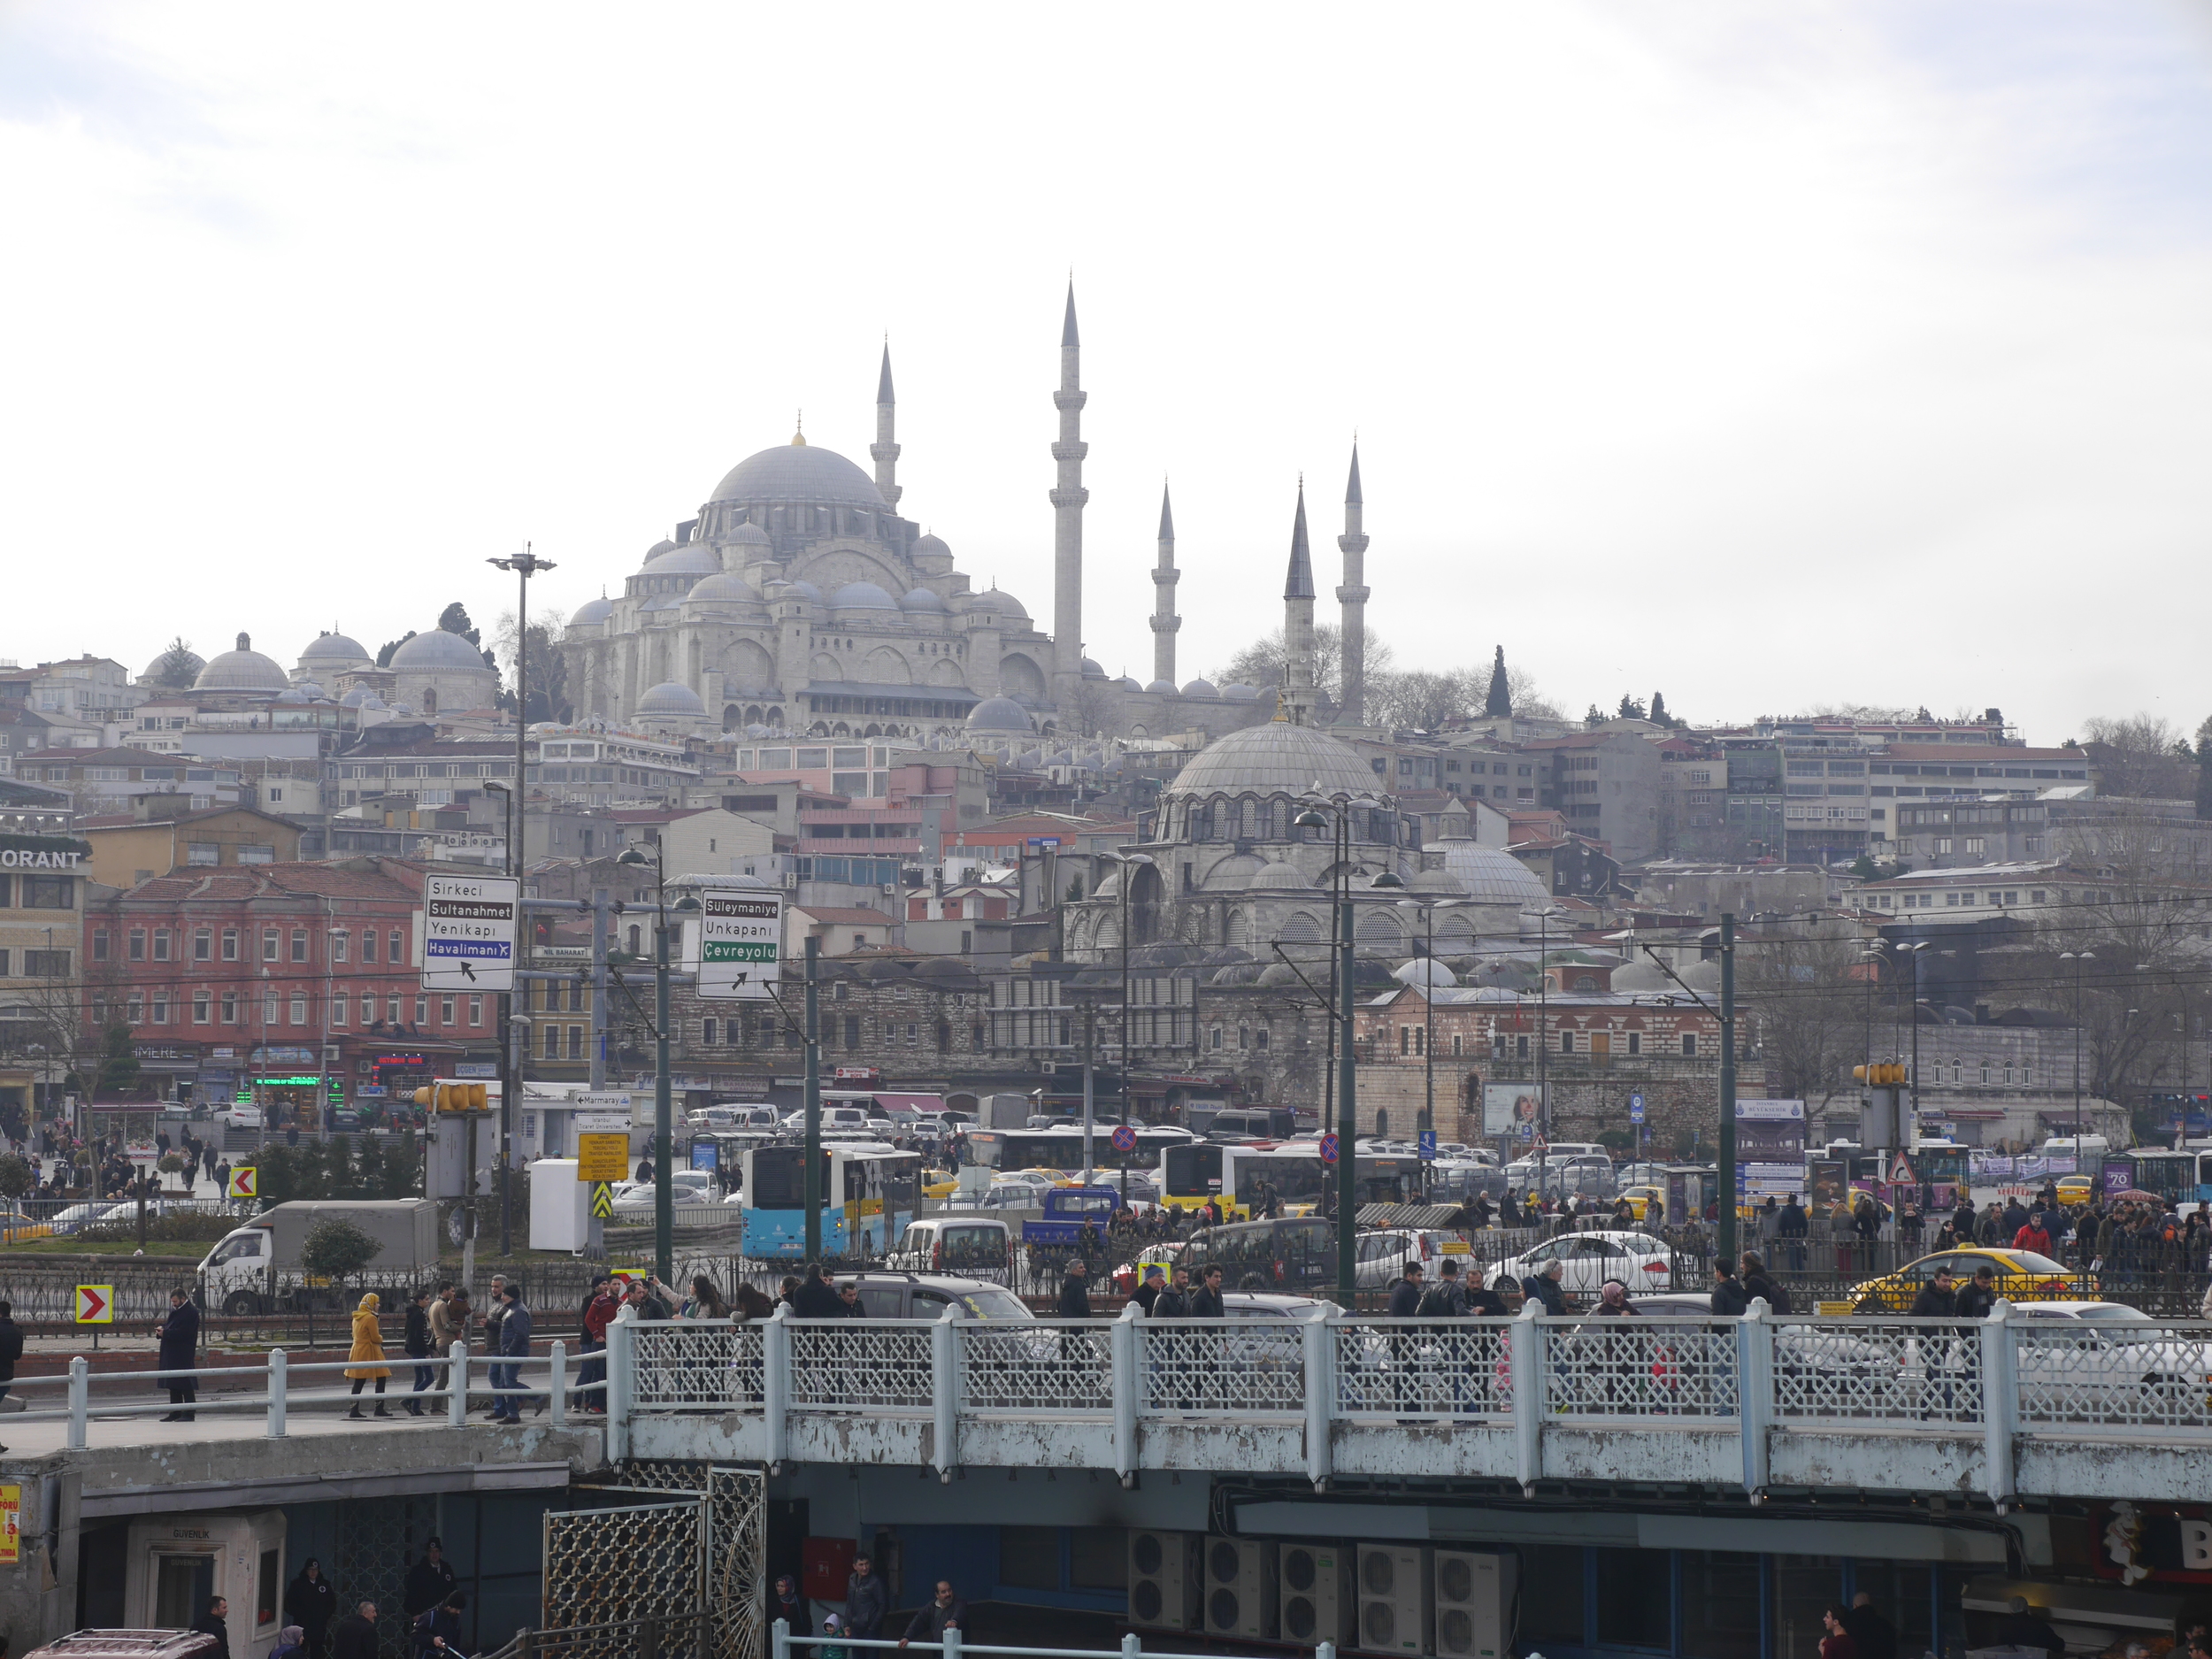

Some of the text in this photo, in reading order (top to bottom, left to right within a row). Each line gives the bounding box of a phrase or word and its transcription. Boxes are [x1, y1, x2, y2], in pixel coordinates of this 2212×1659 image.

[1, 849, 81, 869] ORANT
[433, 882, 482, 896] Sirkeci
[431, 902, 511, 918] Sultanahmet
[707, 901, 778, 917] Süleymaniye
[431, 922, 495, 939] Yenikapı
[706, 921, 772, 939] Unkapanı
[429, 942, 497, 956] Havalimanı
[704, 942, 776, 961] Çevreyolu
[455, 1064, 477, 1076] ÜÇGEN
[584, 1096, 619, 1106] Marmaray
[7, 1523, 16, 1535] 3
[0, 1548, 16, 1557] TINDA
[2180, 1520, 2212, 1570] B
